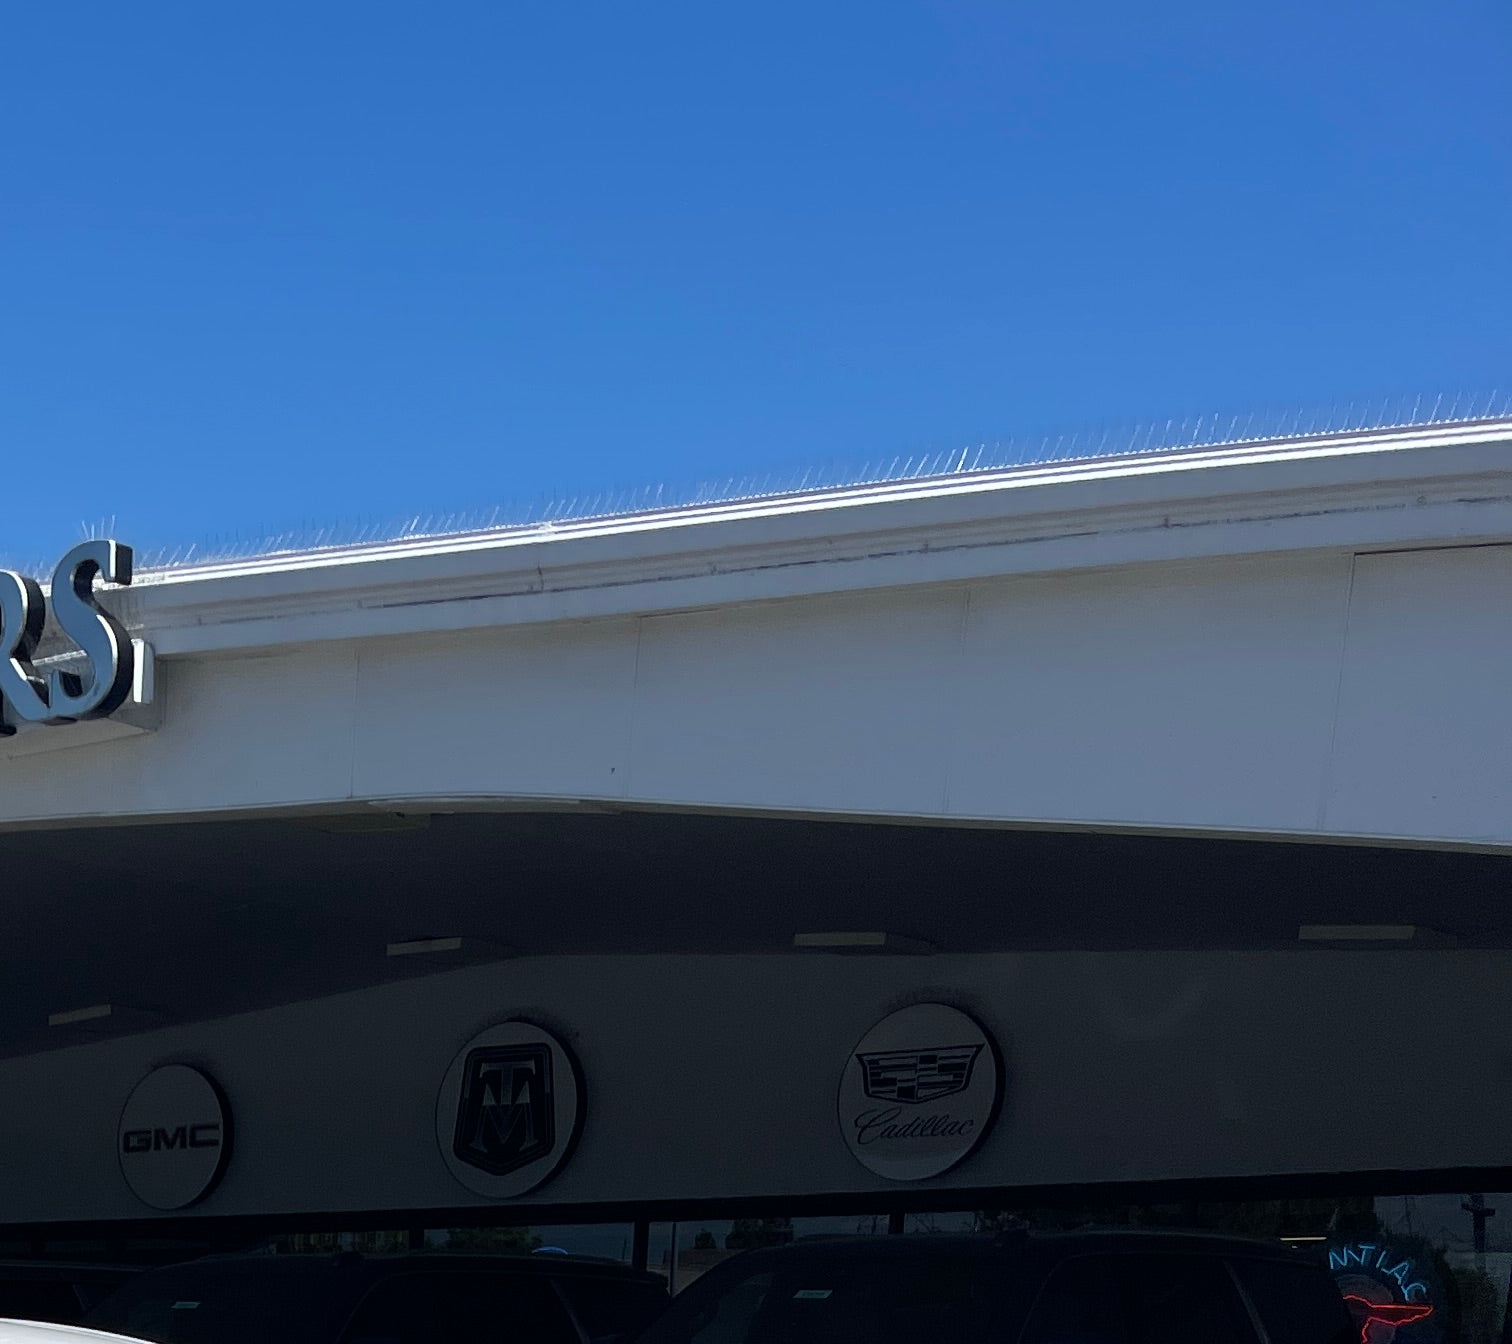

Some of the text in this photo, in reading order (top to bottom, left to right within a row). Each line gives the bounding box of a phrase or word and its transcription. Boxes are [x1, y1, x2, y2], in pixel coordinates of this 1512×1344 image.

[124, 1125, 219, 1153] GMC
[854, 1106, 974, 1145] Cadillac
[1329, 1245, 1427, 1301] NTIAC
